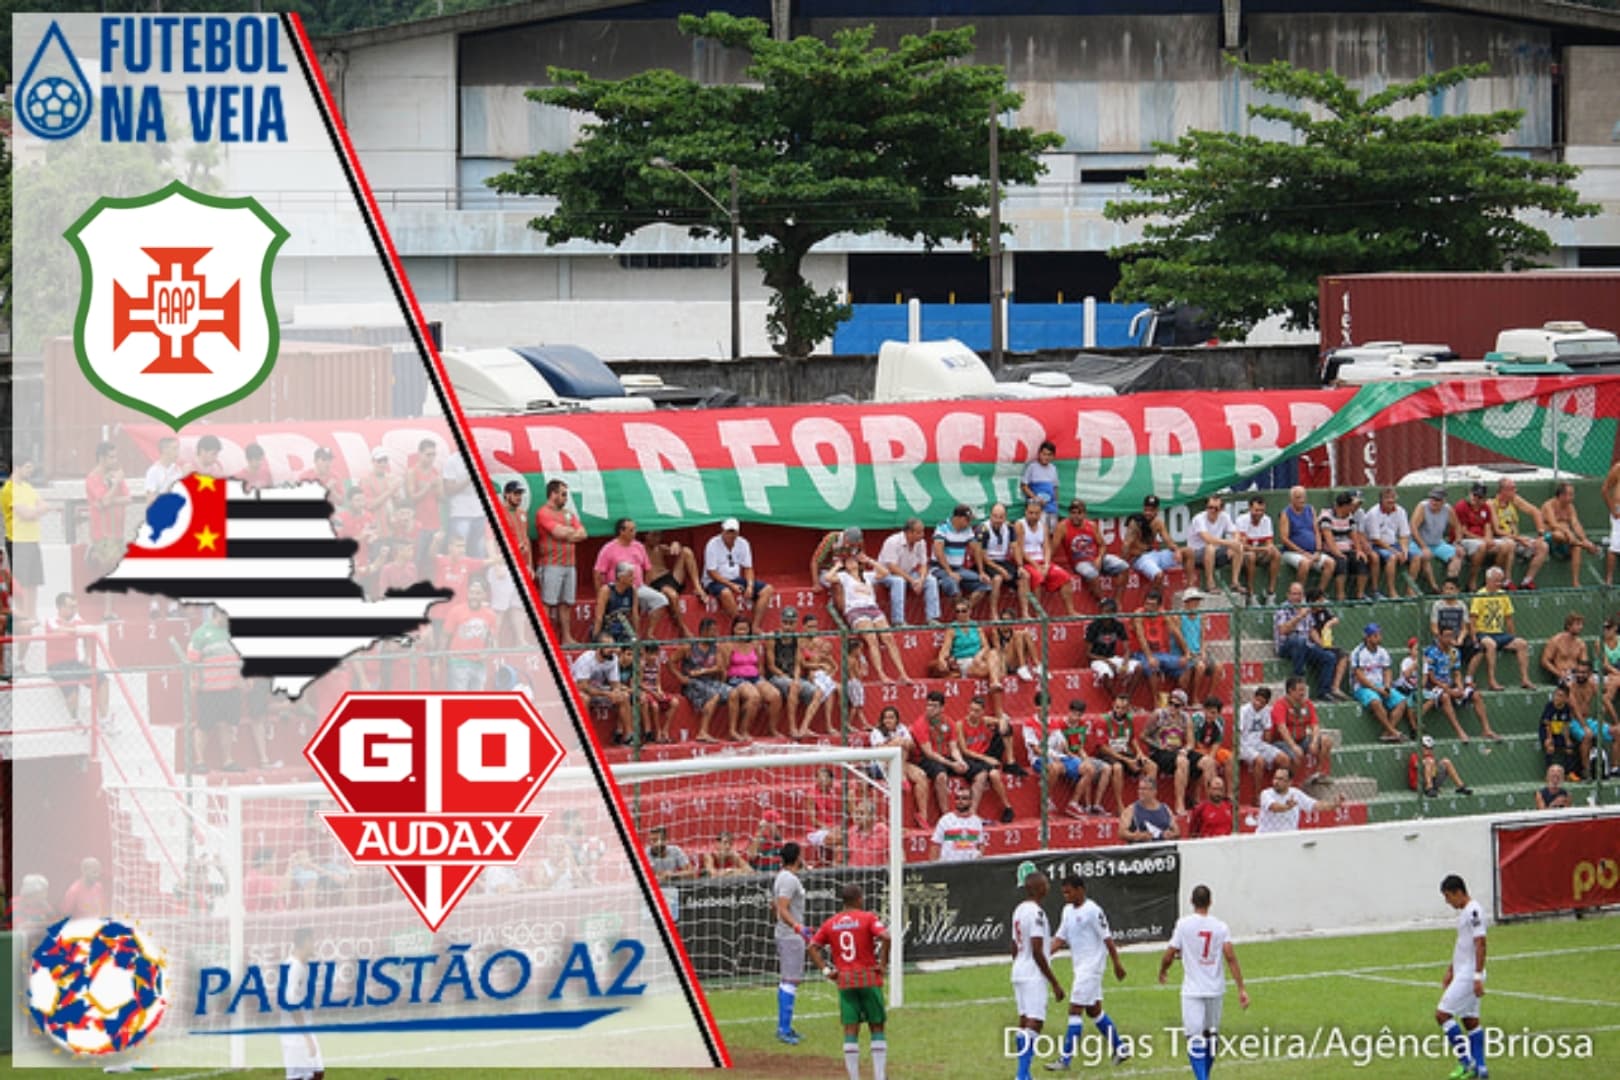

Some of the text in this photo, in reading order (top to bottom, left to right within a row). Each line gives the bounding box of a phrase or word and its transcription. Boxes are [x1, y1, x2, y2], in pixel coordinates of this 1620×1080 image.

[622, 421, 712, 518] A
[1075, 406, 1204, 505] DA
[575, 604, 591, 620] 15
[1005, 829, 1020, 844] 23
[839, 930, 857, 962] 9
[1197, 931, 1213, 959] 7
